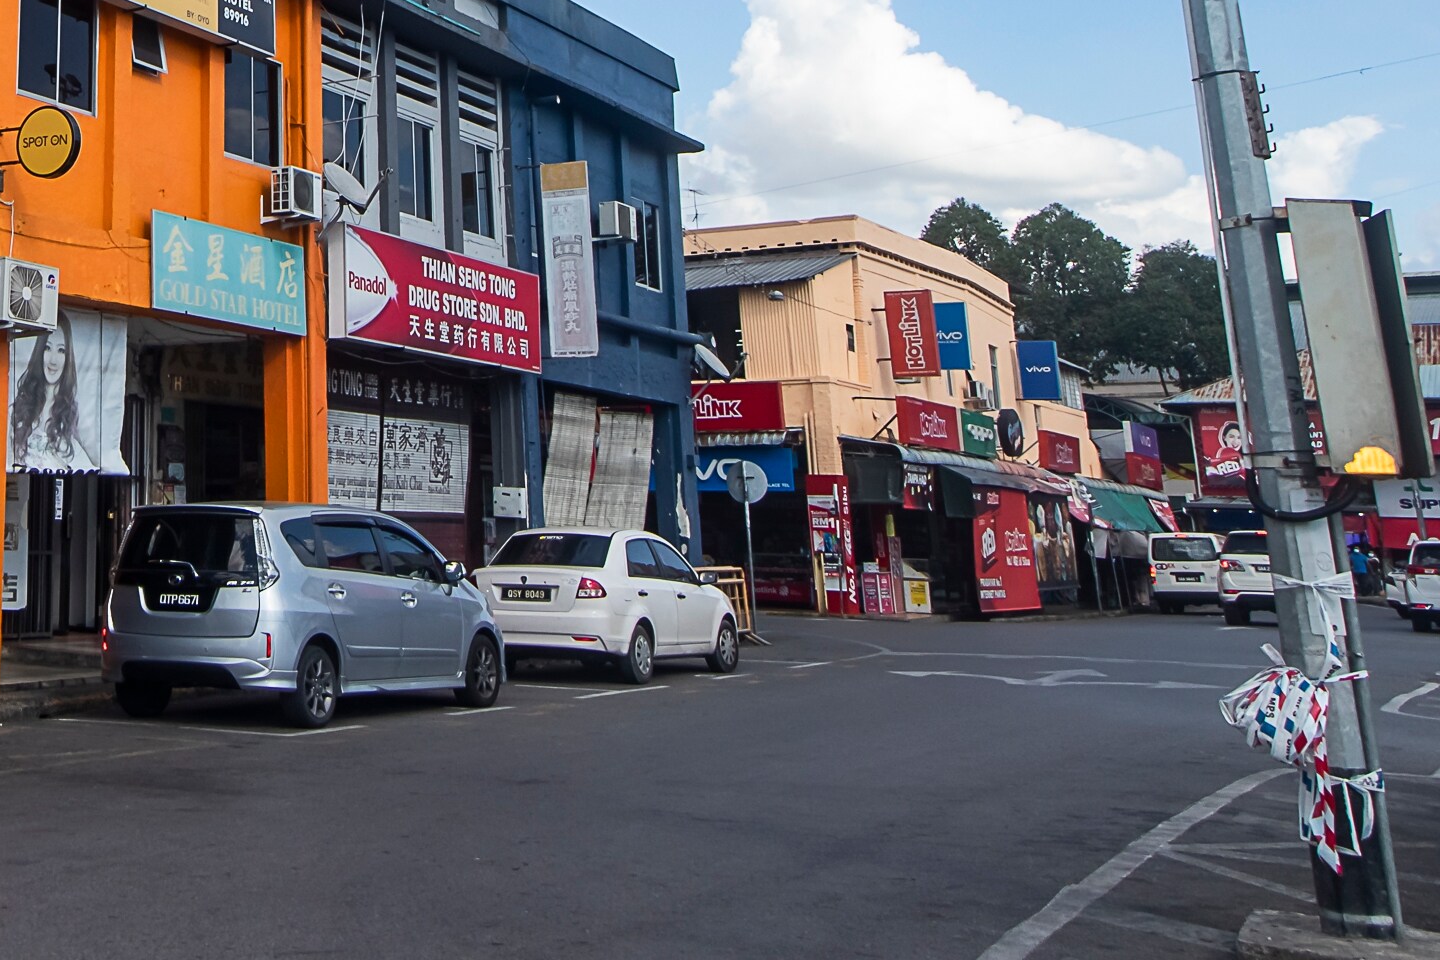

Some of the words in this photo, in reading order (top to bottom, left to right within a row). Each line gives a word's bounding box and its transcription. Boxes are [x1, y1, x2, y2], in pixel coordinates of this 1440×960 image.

[197, 14, 210, 26] OYO
[223, 7, 249, 27] 89916
[23, 136, 48, 148] SPOT
[50, 134, 68, 146] ON
[162, 224, 298, 298] 金星酒店
[348, 271, 387, 296] Panadol
[421, 256, 456, 284] THIAN
[458, 266, 486, 292] SENG
[488, 273, 516, 299] TONG
[160, 278, 207, 307] GOLD
[211, 289, 248, 317] STAR
[252, 297, 302, 326] HOTEL
[409, 285, 440, 311] DRUG
[442, 293, 477, 321] STORE
[479, 302, 503, 326] SDN.
[504, 307, 528, 332] BHD.
[409, 315, 529, 359] 天生堂药行有限公司
[338, 369, 362, 397] TONG
[159, 594, 199, 605] QTP6671
[507, 589, 522, 598] QSY
[525, 590, 545, 599] 8049
[1265, 697, 1277, 718] MPS
